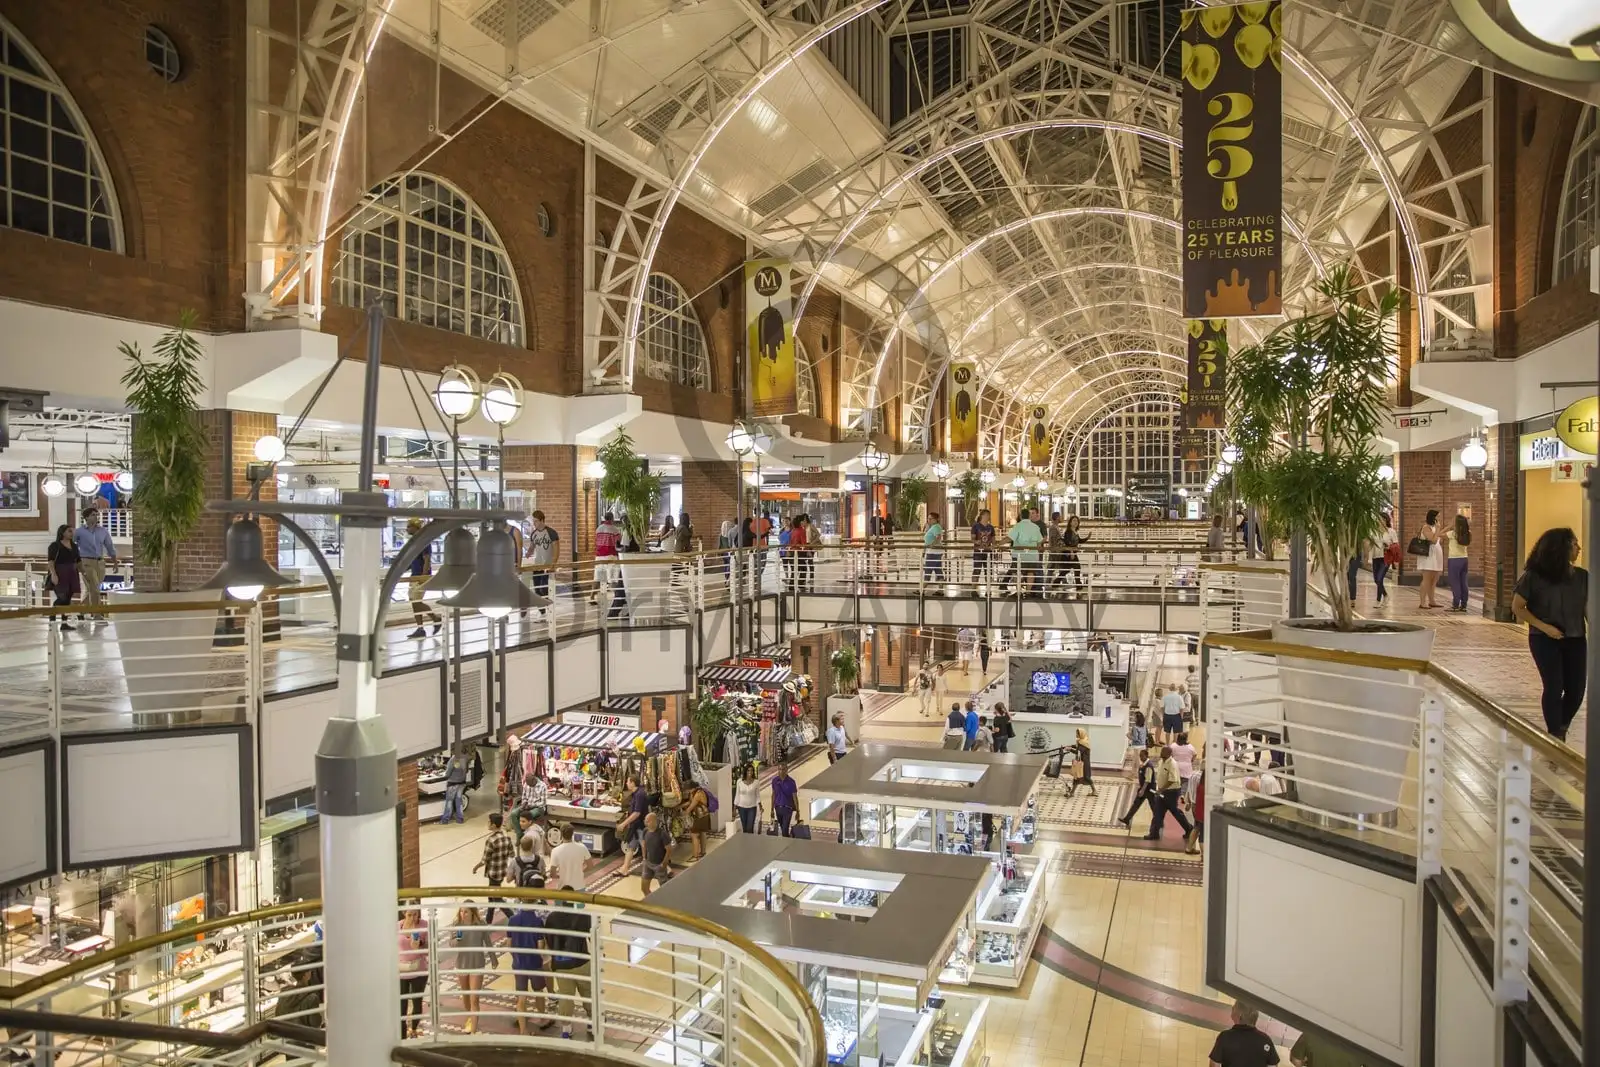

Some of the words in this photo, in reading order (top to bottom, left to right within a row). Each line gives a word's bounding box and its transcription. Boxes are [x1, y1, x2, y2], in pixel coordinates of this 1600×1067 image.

[1187, 214, 1275, 230] CELEBRATING
[1187, 233, 1209, 247] 25
[1214, 229, 1275, 246] YEARS
[1188, 250, 1204, 260] OF
[1209, 246, 1275, 259] PLEASURE
[757, 271, 777, 287] M
[589, 714, 620, 726] guava
